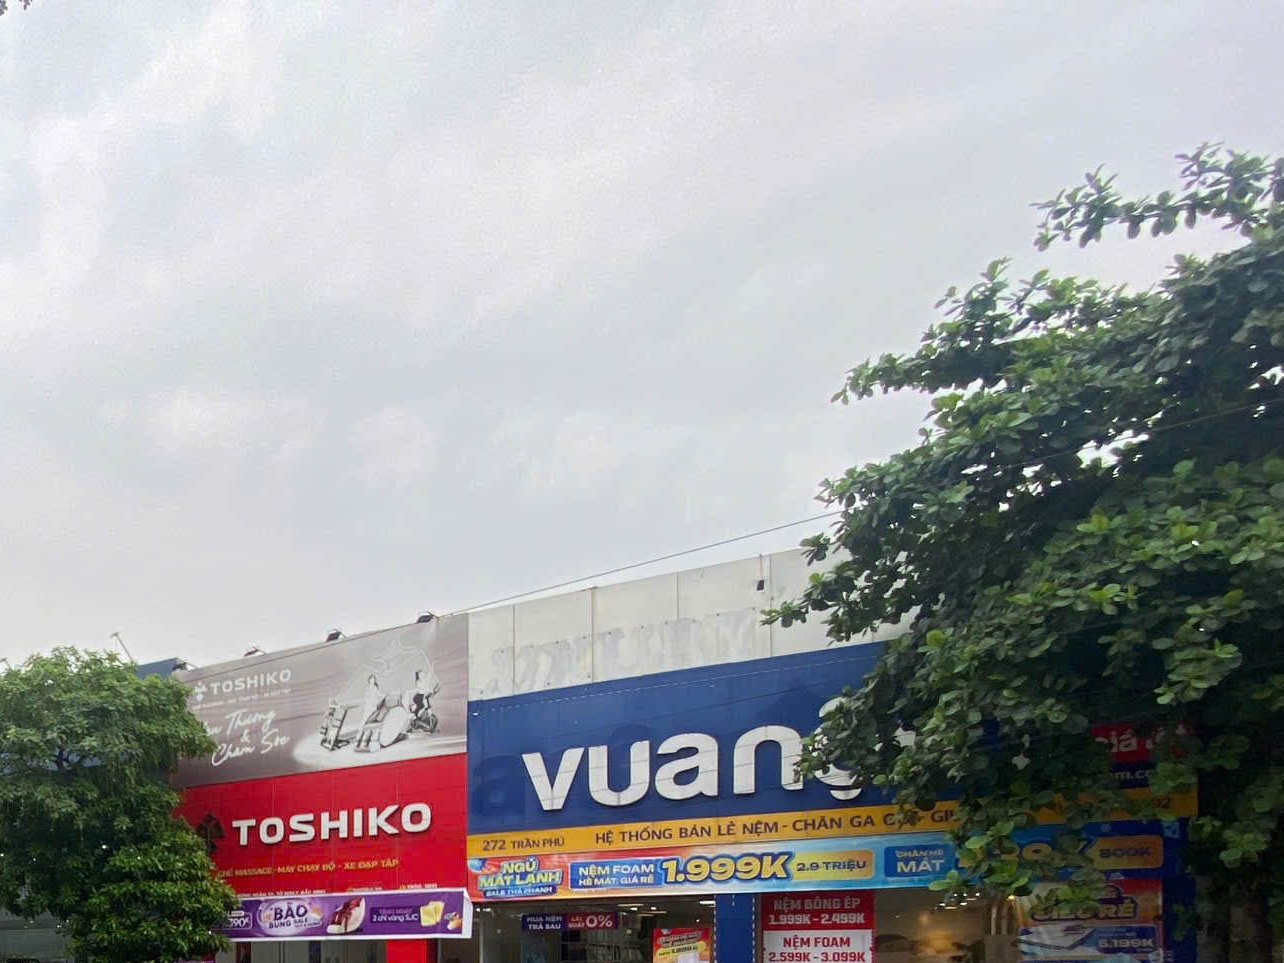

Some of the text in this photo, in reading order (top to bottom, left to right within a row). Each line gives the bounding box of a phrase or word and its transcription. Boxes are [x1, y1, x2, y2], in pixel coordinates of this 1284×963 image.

[211, 669, 291, 695] TOSHIKO
[521, 698, 916, 811] vuan
[231, 802, 433, 847] TOSHIKO
[595, 830, 614, 846] HỆ
[619, 826, 672, 842] THỐNG
[679, 823, 711, 839] BÁN
[717, 820, 736, 837] LẺ
[742, 820, 779, 837] NỆM
[792, 815, 842, 832] CHĂN
[849, 814, 876, 828] GA
[483, 836, 565, 851] 272 TRẦN PHÚ
[343, 861, 356, 870] XE
[503, 857, 536, 873] NGỦ
[579, 863, 655, 878] NỆM FOAM
[661, 853, 793, 885] 1.999K
[822, 858, 868, 874] TRIỆU
[897, 857, 945, 873] MÁT
[774, 897, 801, 914] NỆM
[269, 919, 292, 929] BUNG
[586, 914, 613, 928] 0%
[769, 913, 811, 925] 1.999K
[821, 913, 865, 924] 2.499K
[783, 935, 851, 950] NỆM FOAM
[768, 951, 811, 962] 2.599K
[821, 951, 866, 963] 3.099K
